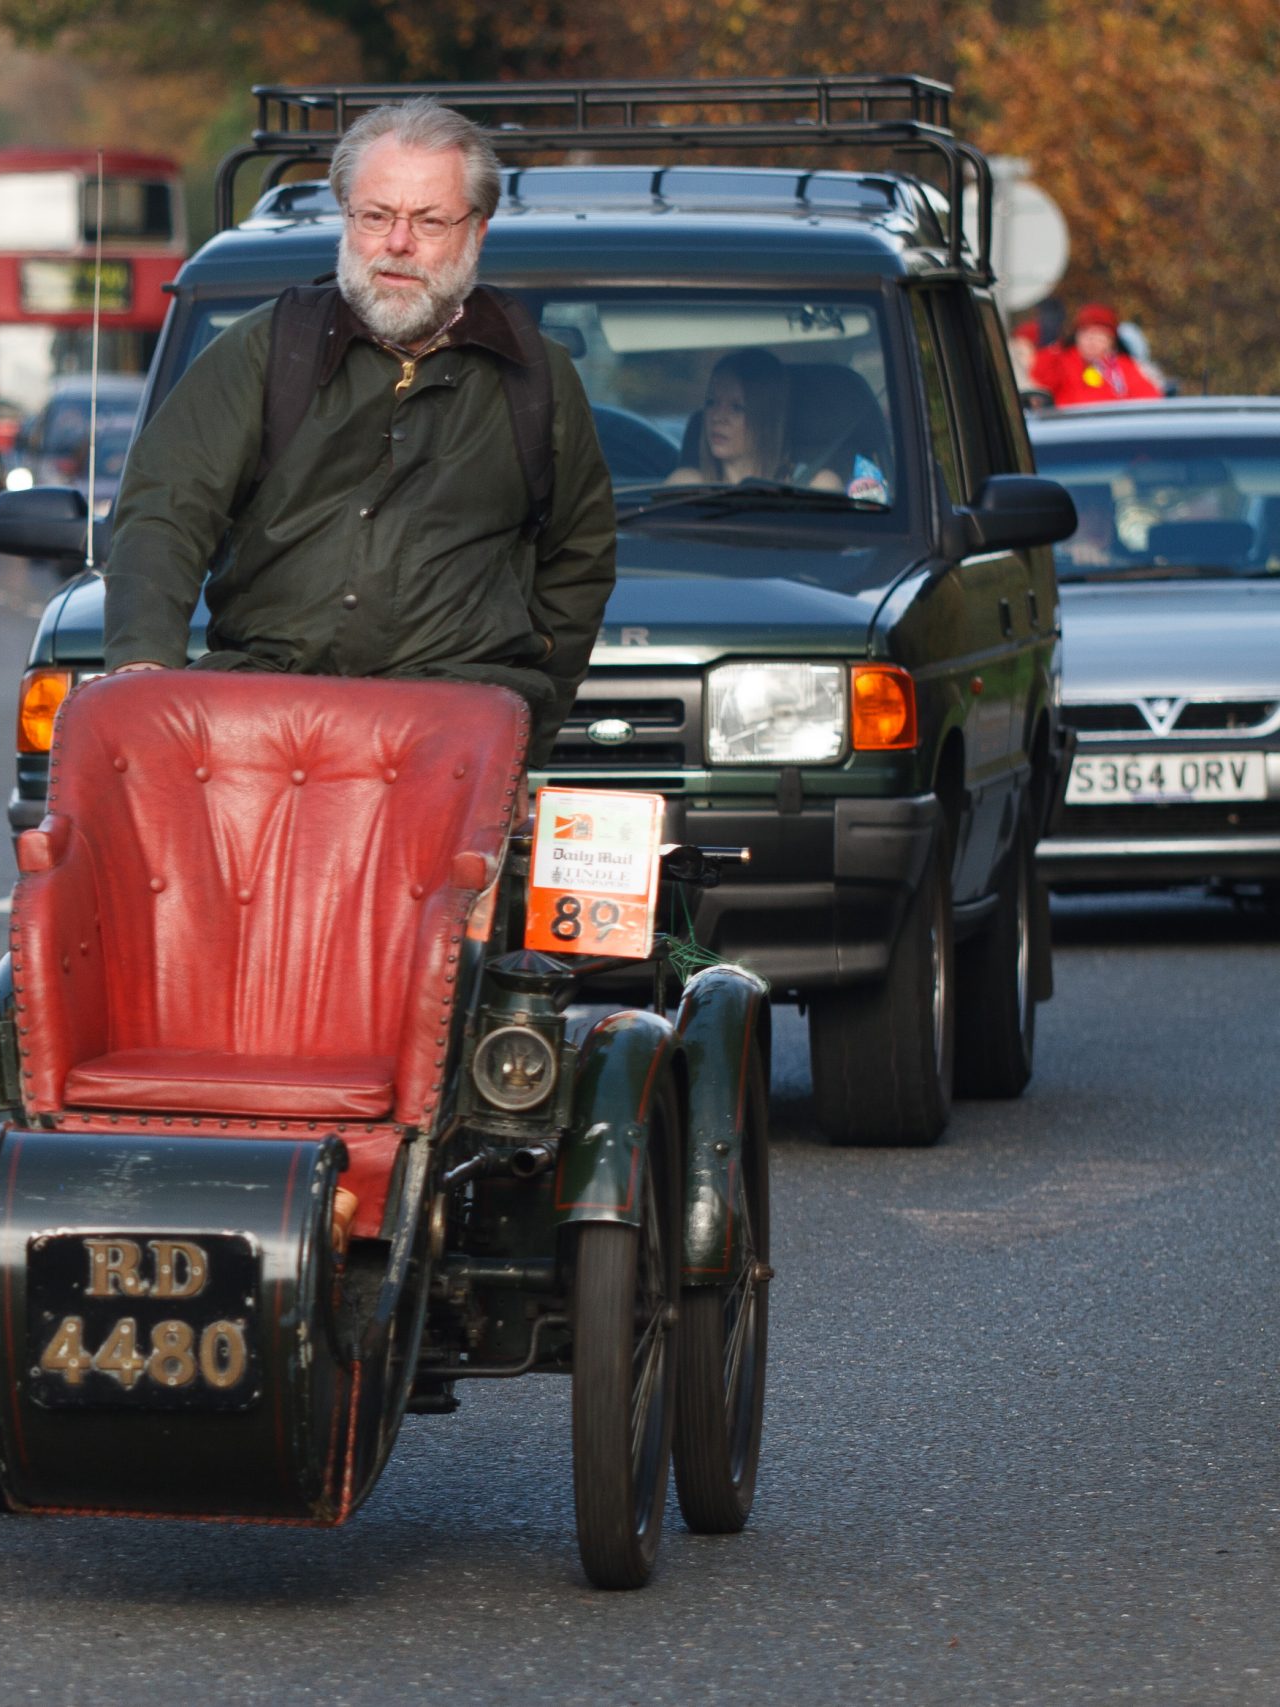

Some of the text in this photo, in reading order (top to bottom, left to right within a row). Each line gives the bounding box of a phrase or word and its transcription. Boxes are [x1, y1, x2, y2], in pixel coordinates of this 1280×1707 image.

[1074, 761, 1247, 793] S364 ORV
[553, 848, 633, 866] Daily Mail
[562, 867, 631, 882] TINDLE
[551, 896, 621, 943] 89
[83, 1238, 209, 1297] RD
[41, 1316, 247, 1389] 4480
